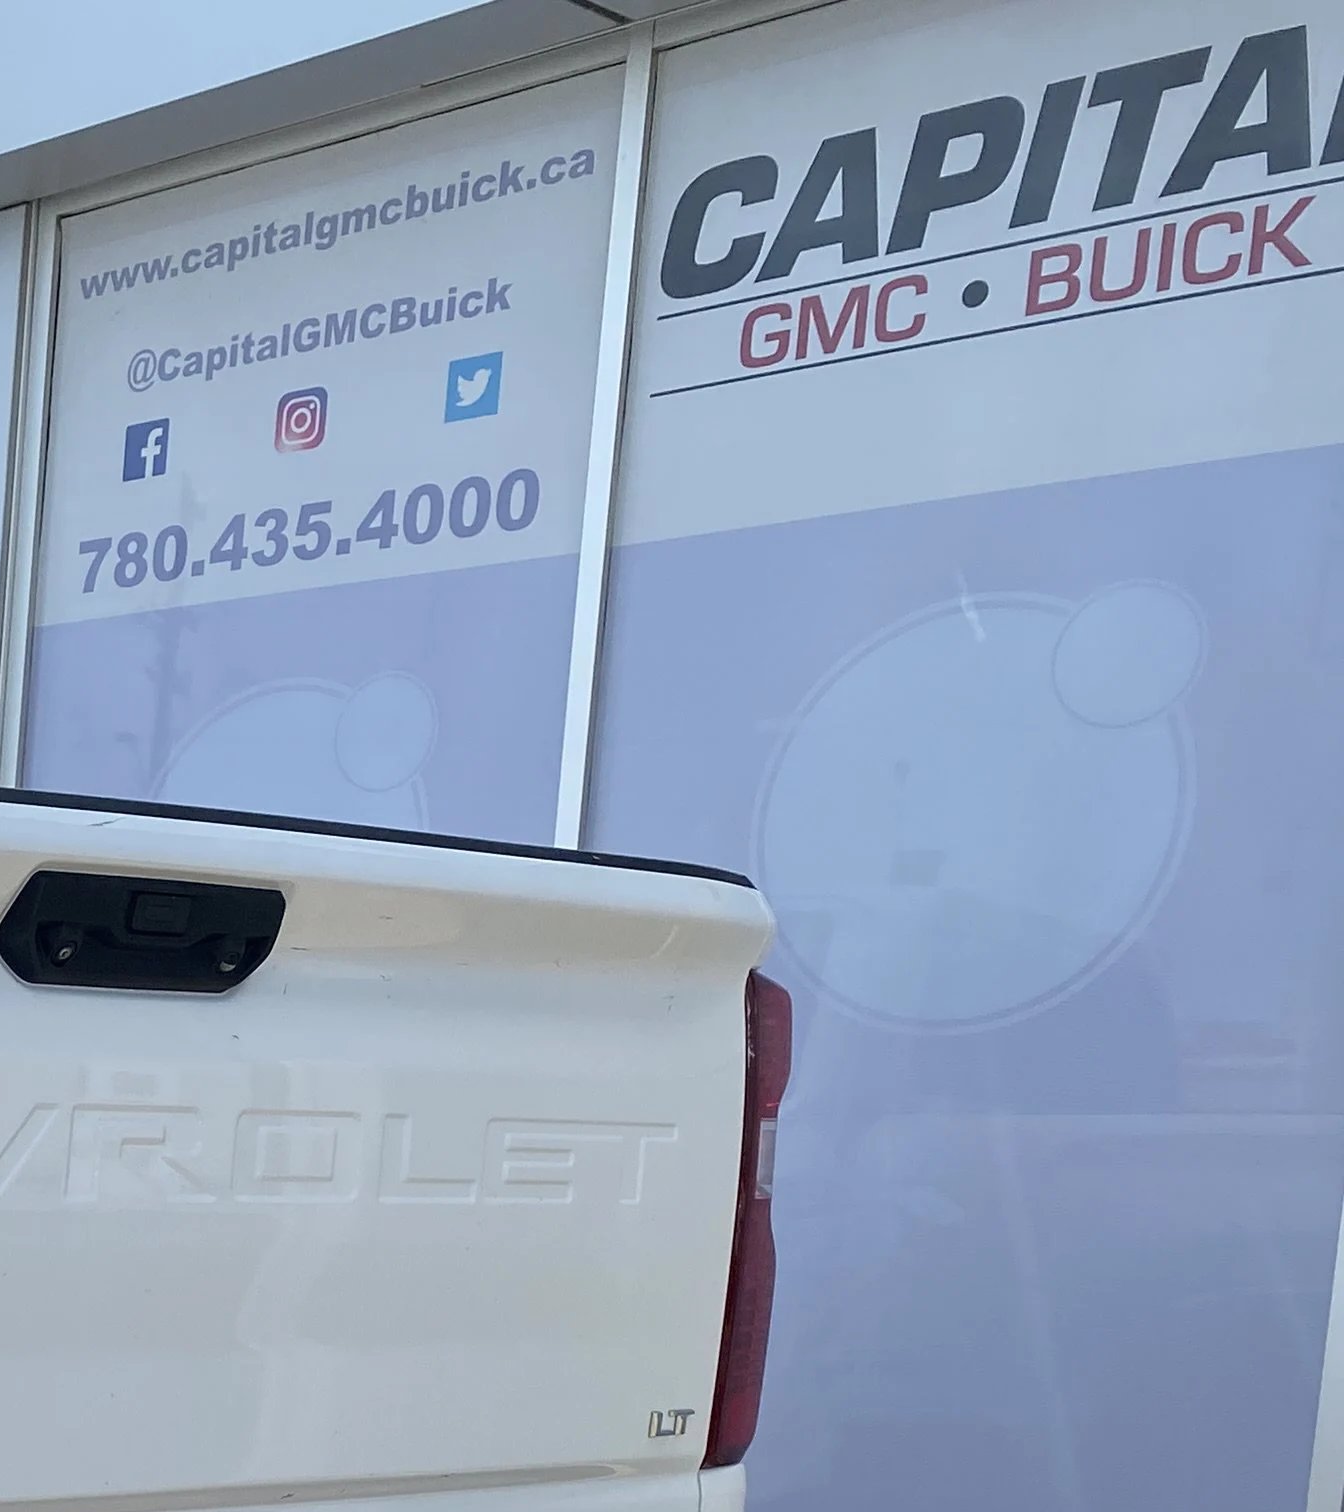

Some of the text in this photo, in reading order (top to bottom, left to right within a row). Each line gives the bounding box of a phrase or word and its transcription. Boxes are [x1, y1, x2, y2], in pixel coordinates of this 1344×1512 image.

[80, 148, 595, 300] www.capitalgmcbuick.ca
[660, 25, 1344, 299] CAPITA
[127, 277, 512, 392] @CapitalGMCBuick
[739, 195, 1316, 368] GMC BUICK
[78, 468, 540, 594] 780.435.4000
[648, 1409, 695, 1438] LT
